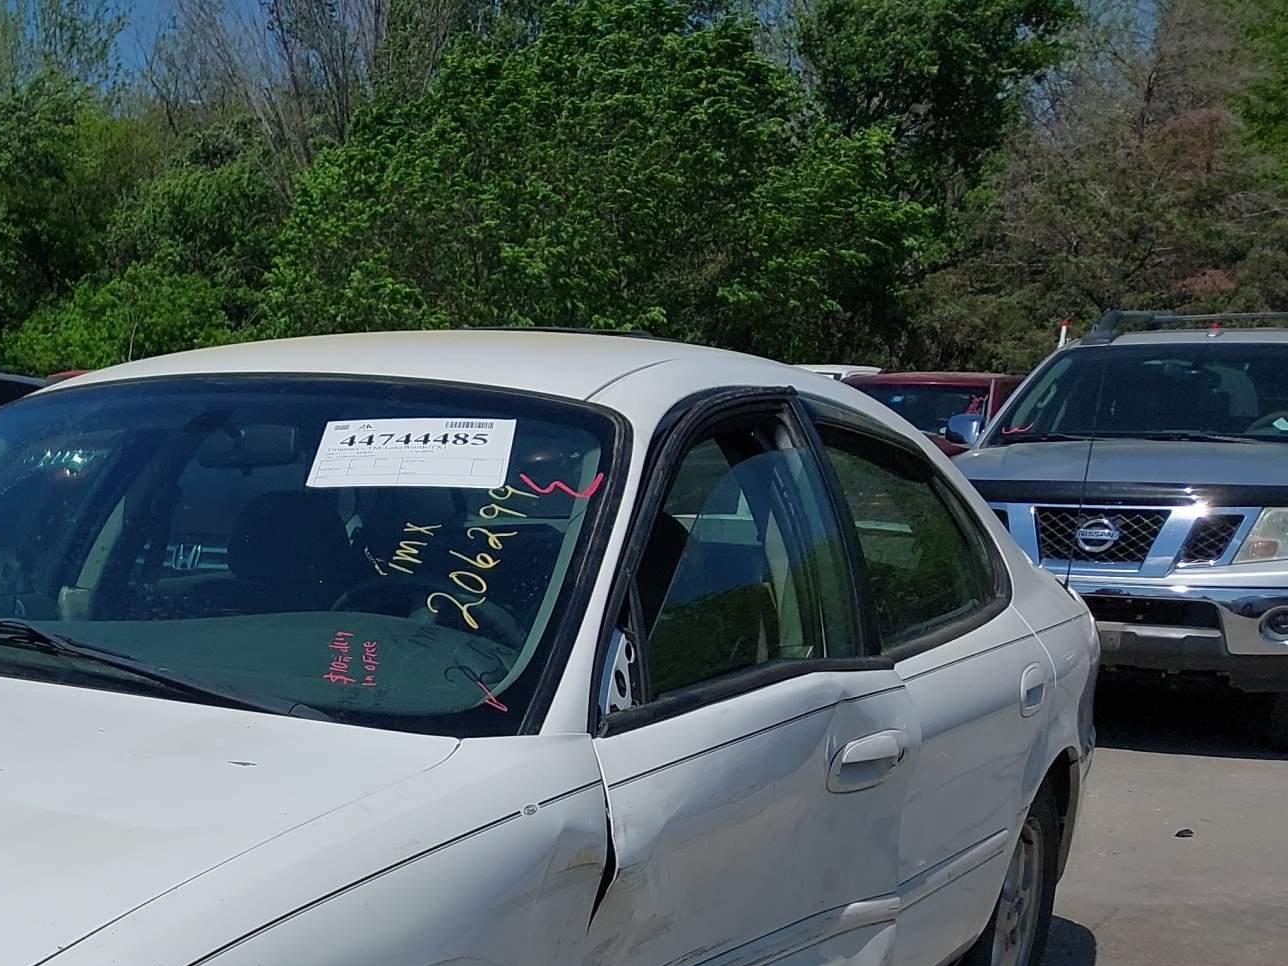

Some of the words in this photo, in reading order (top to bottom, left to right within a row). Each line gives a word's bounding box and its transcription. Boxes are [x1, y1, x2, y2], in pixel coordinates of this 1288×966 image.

[339, 432, 490, 447] 44744485
[1078, 529, 1114, 538] NISSAN
[426, 484, 541, 630] 206299
